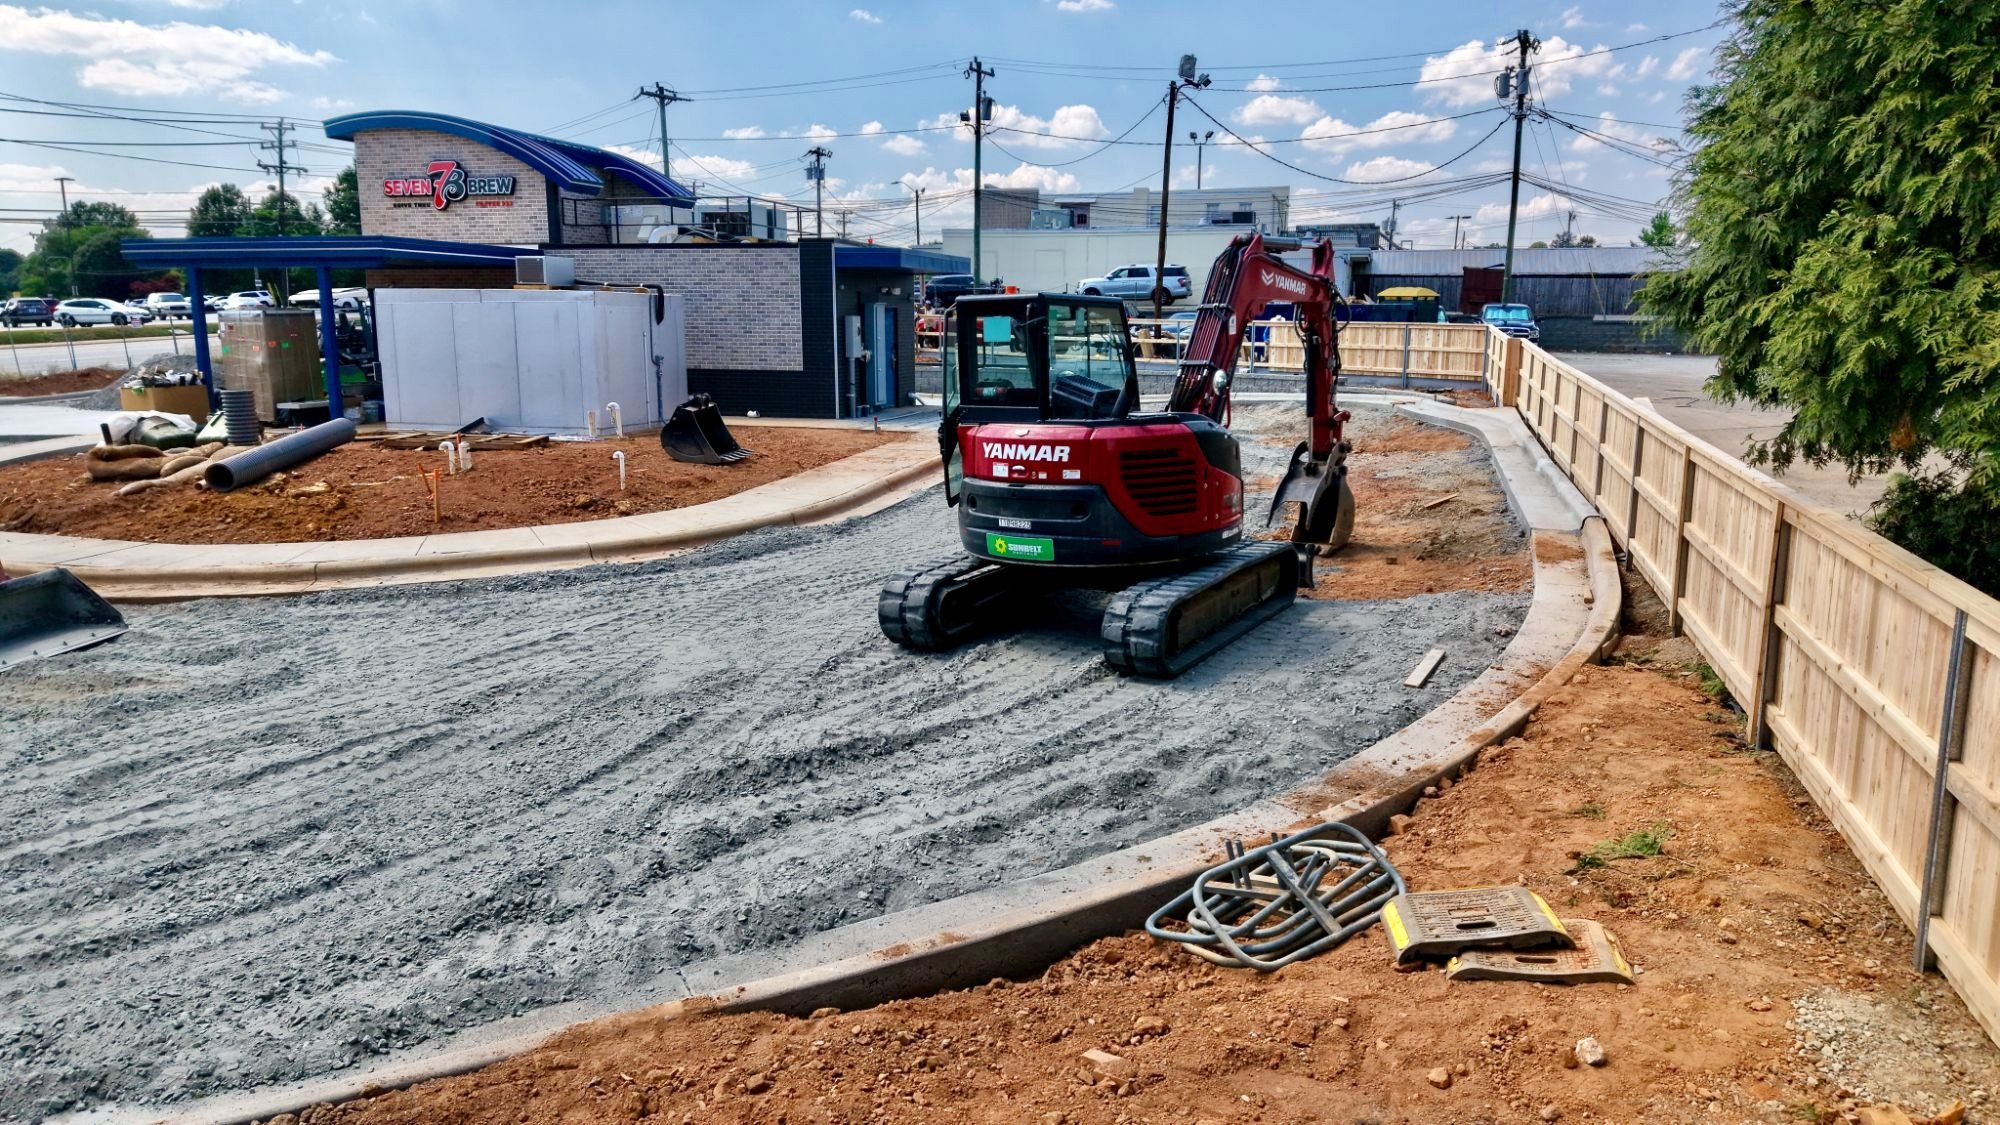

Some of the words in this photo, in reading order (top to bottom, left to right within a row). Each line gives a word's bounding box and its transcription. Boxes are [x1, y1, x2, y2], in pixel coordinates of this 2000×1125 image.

[384, 178, 433, 195] SEVEN
[467, 176, 513, 194] BREW
[1275, 275, 1307, 295] YANMAR
[982, 442, 1070, 462] YANMAR
[1008, 543, 1043, 553] SUNBELT
